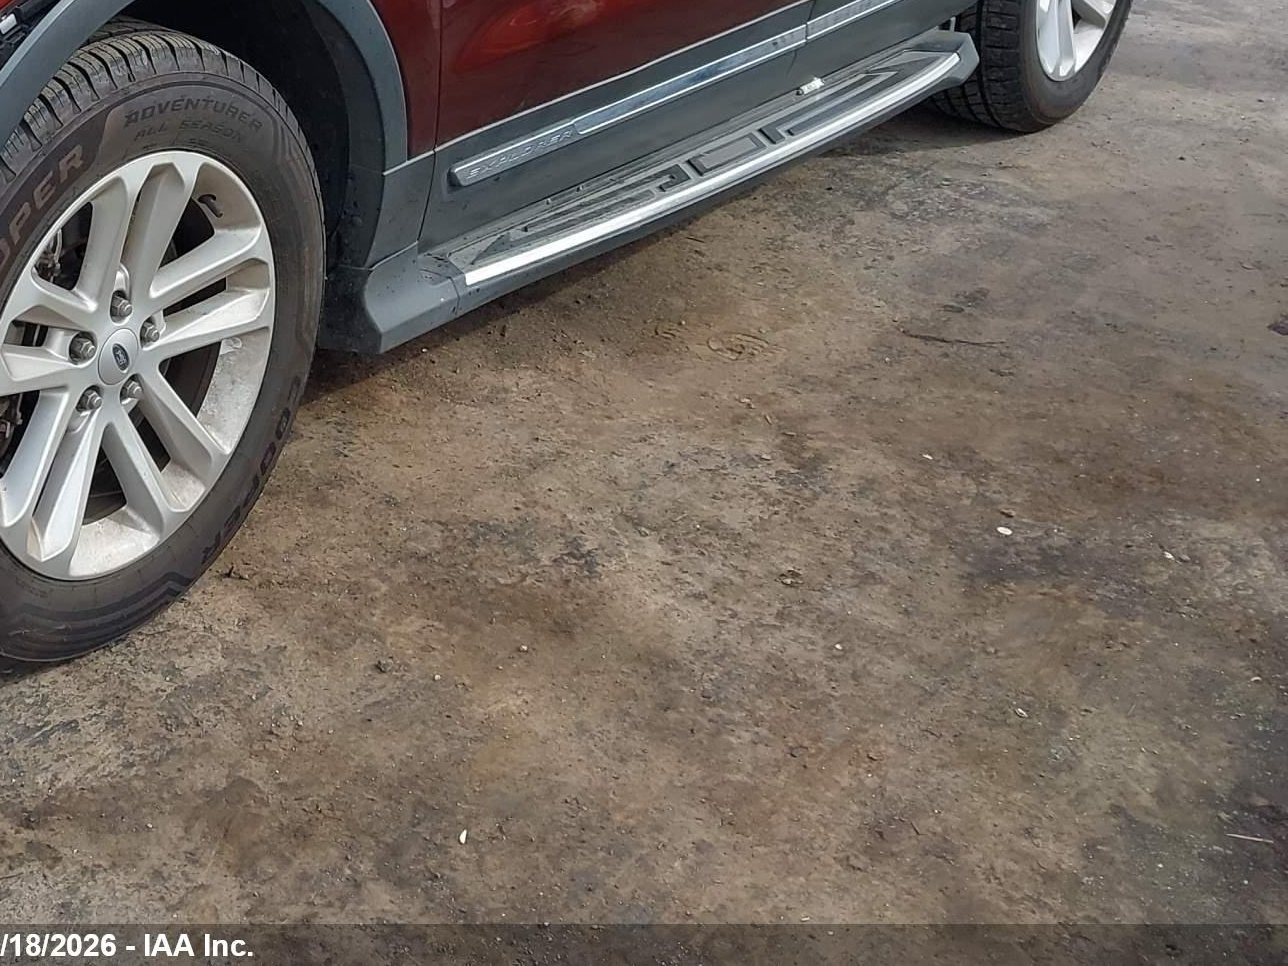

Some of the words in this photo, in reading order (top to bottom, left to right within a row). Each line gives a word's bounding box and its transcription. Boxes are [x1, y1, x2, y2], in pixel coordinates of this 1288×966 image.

[123, 94, 264, 134] ADVENTURER
[133, 123, 168, 142] ALL
[178, 119, 246, 144] SEASON
[466, 129, 573, 180] EXPLORER
